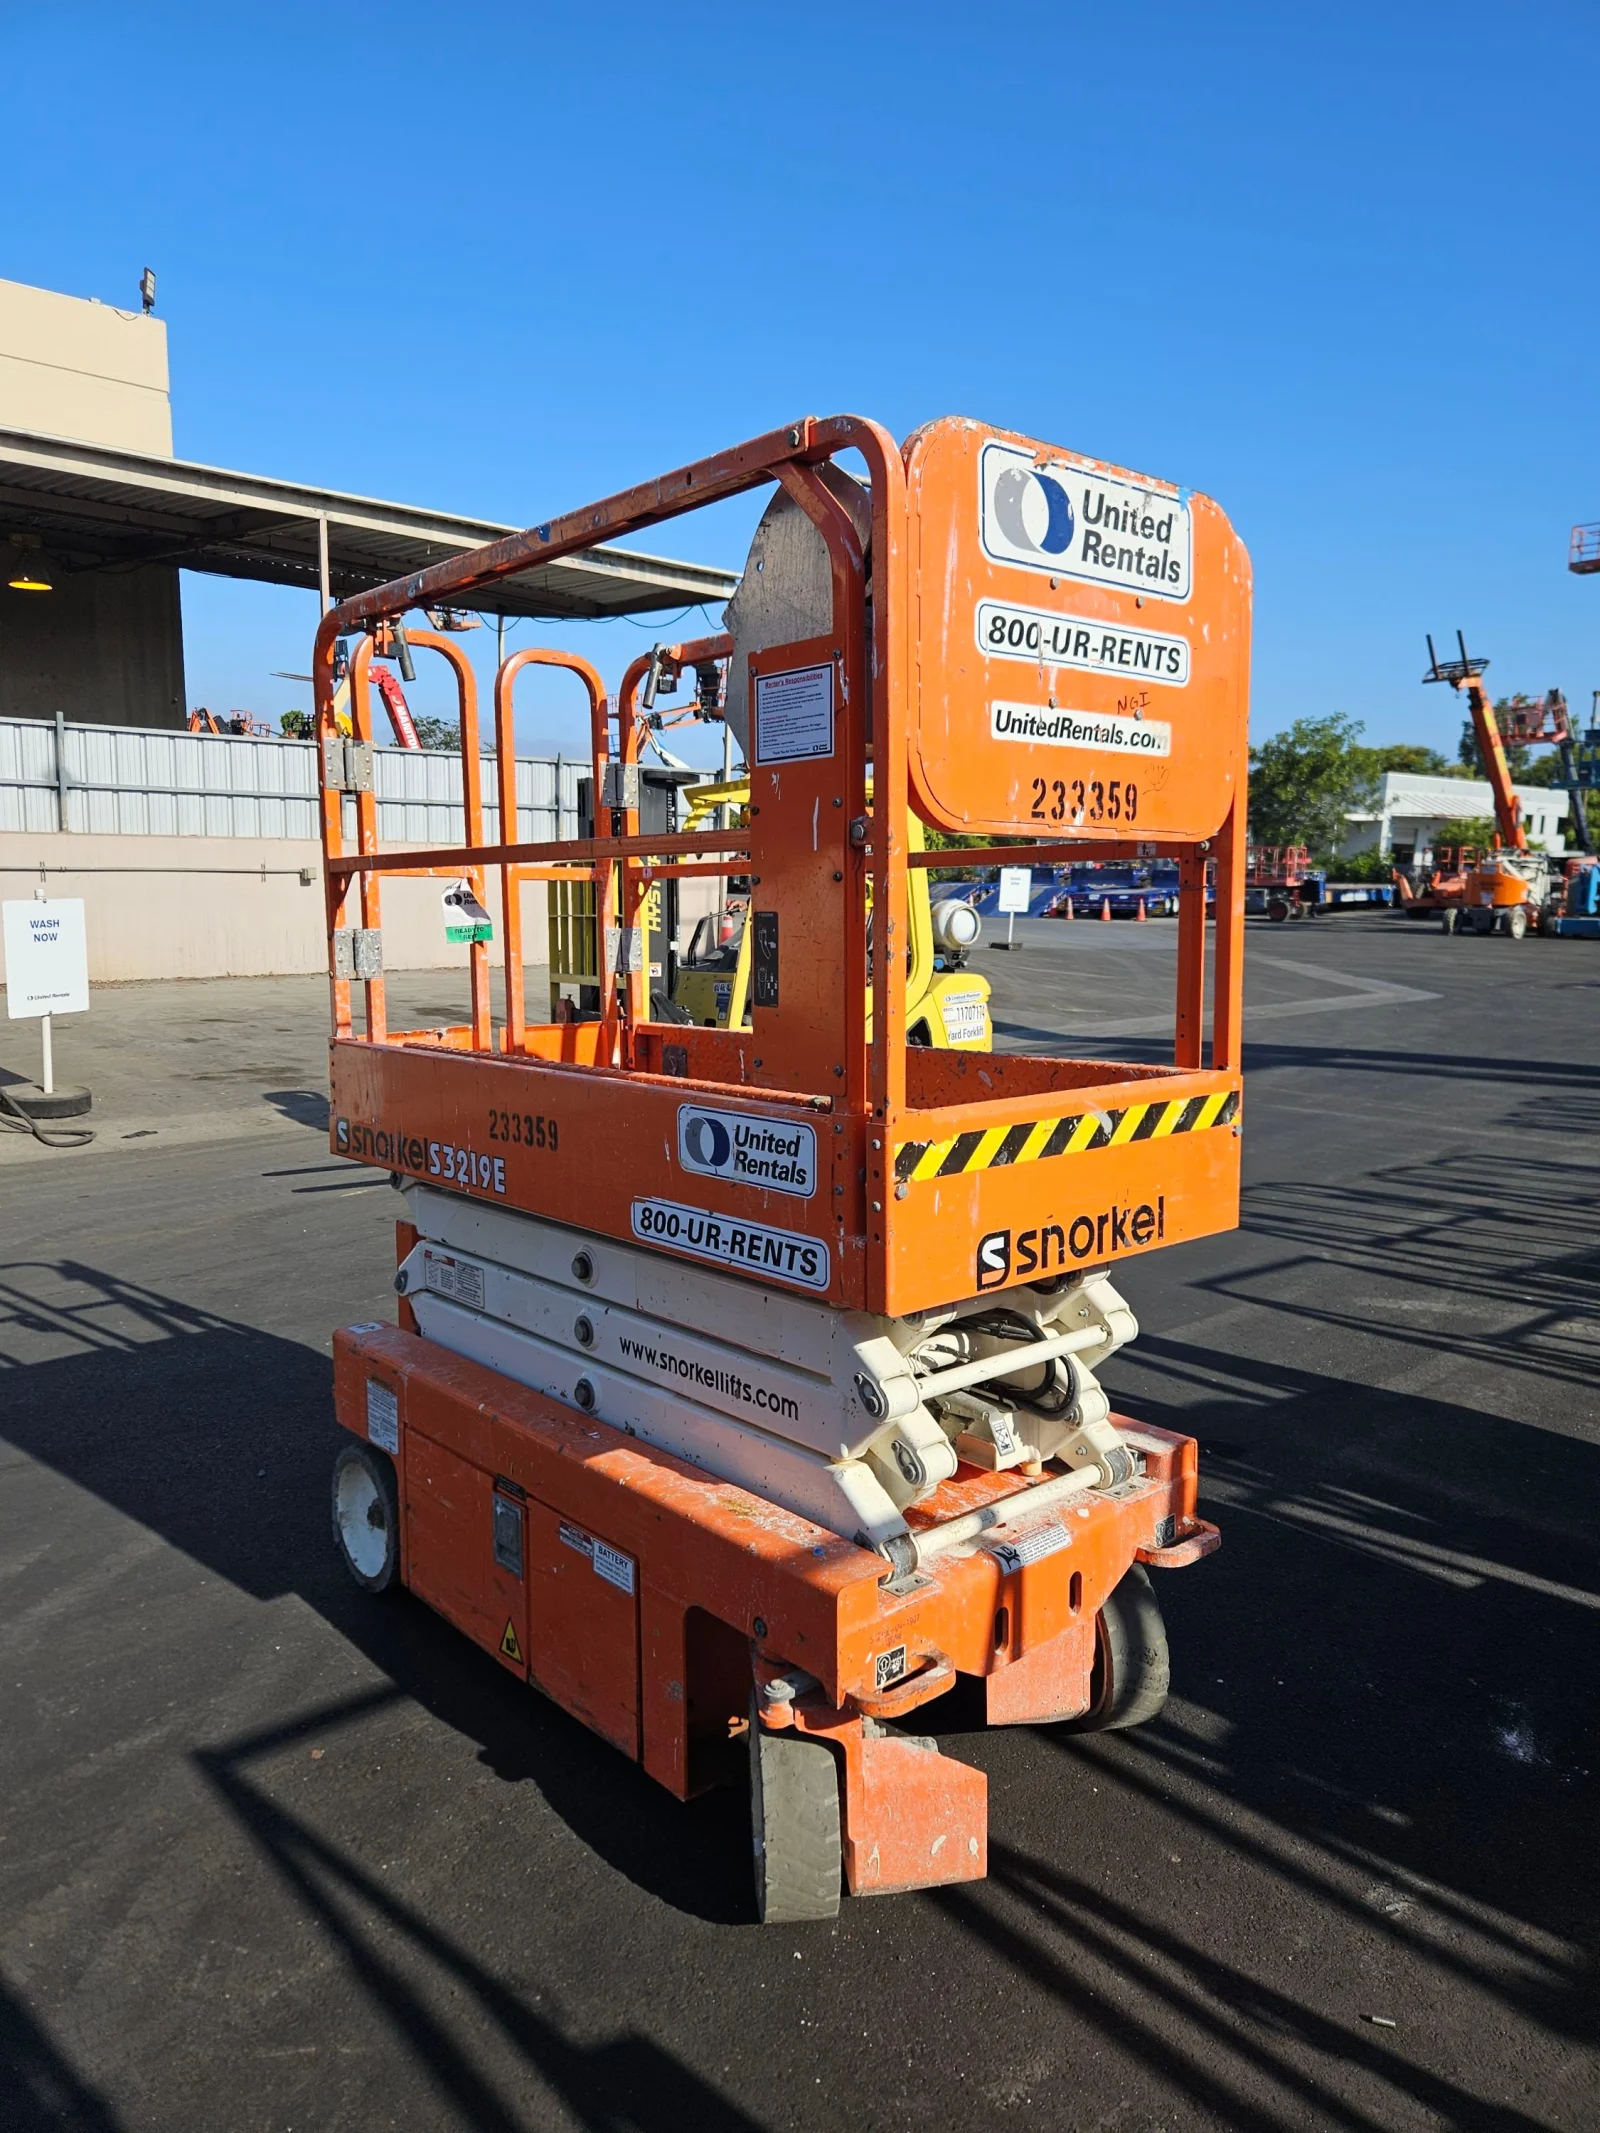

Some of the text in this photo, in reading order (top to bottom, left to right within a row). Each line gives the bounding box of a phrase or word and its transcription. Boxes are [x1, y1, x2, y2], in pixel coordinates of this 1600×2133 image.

[1082, 489, 1173, 544] United
[1081, 530, 1181, 583] Rentals
[988, 615, 1181, 675] 800-UR-RENTS
[995, 709, 1169, 750] UnitedRentals.com
[1031, 777, 1138, 821] 233359
[30, 919, 60, 928] WASH
[34, 933, 58, 942] NOW
[489, 1109, 559, 1152] 233359
[733, 1124, 801, 1157] United
[429, 1141, 506, 1194] S3219E
[733, 1150, 807, 1185] Rentals
[640, 1207, 818, 1276] 800-UR-RENTS
[1016, 1196, 1164, 1275] snorkel
[619, 1336, 799, 1421] www.snorkellifts.com
[598, 1545, 628, 1569] BATTERY
